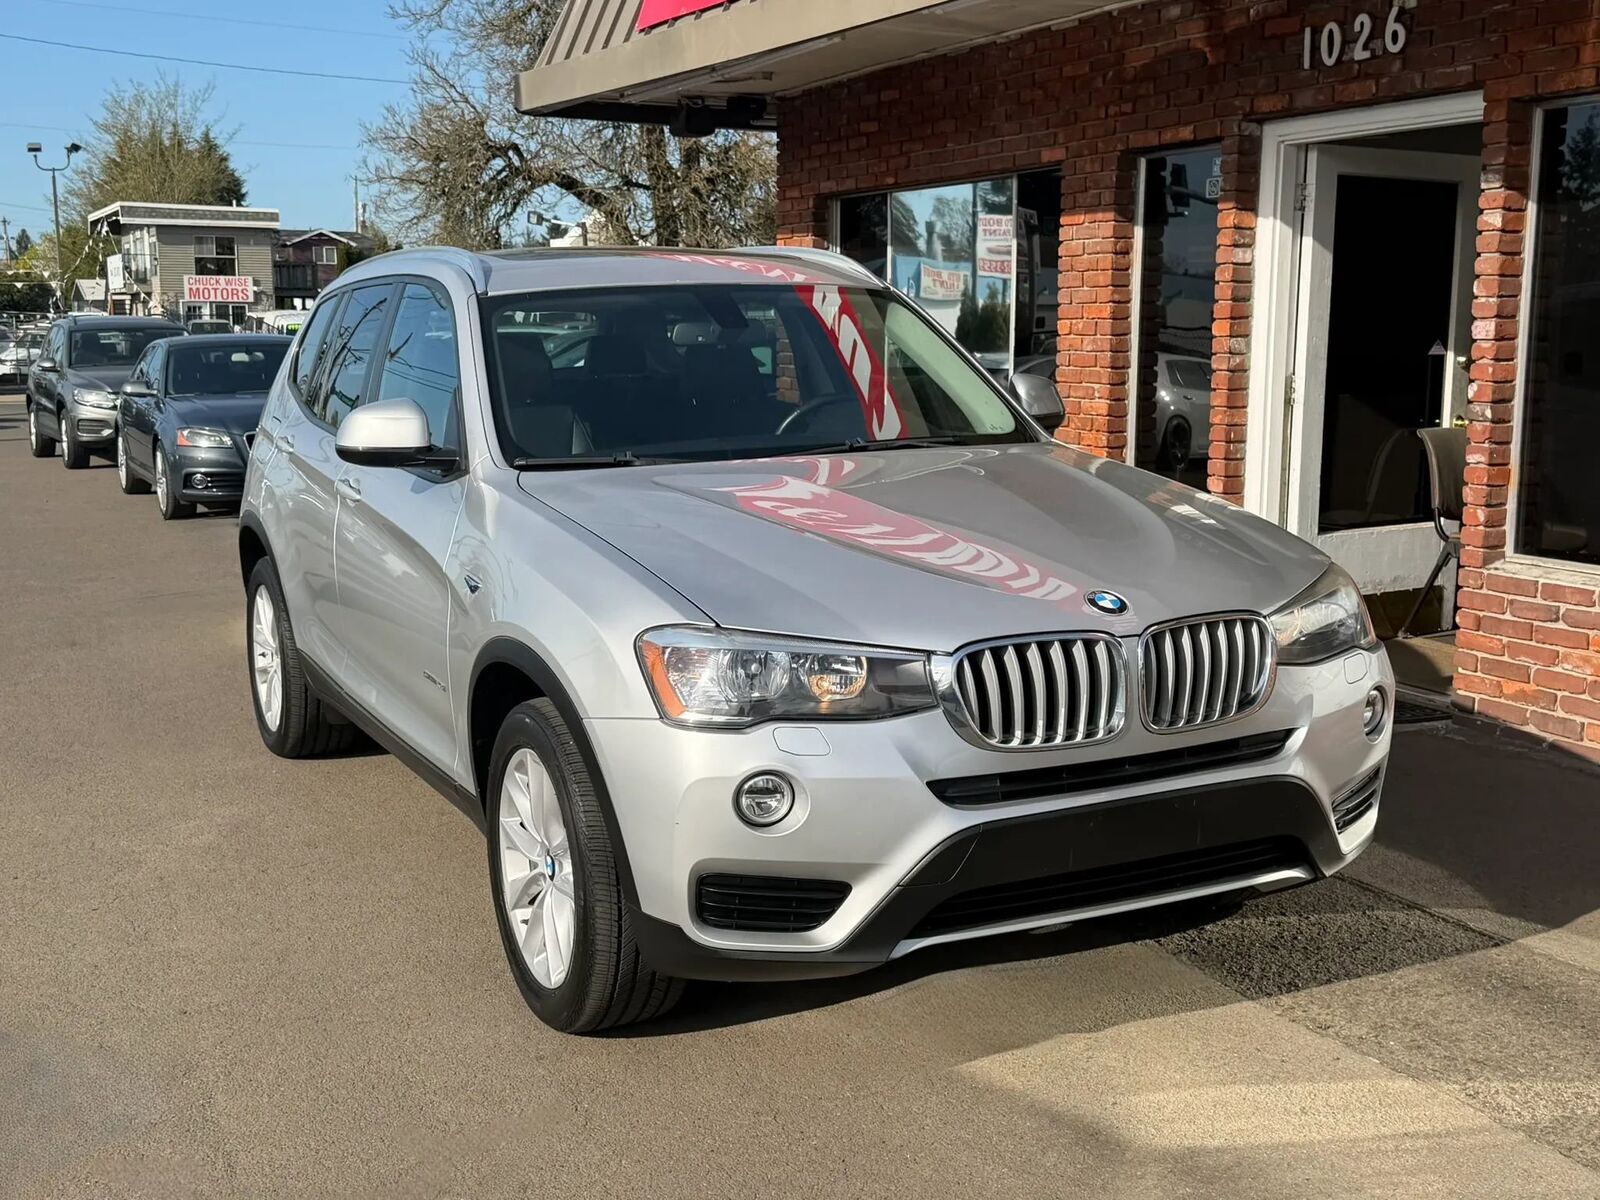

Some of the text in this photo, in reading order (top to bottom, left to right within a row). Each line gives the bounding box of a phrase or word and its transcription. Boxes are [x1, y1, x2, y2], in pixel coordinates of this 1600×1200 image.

[1303, 6, 1406, 70] 1026
[187, 276, 249, 287] CHUCK WISE
[188, 287, 249, 300] MOTORS
